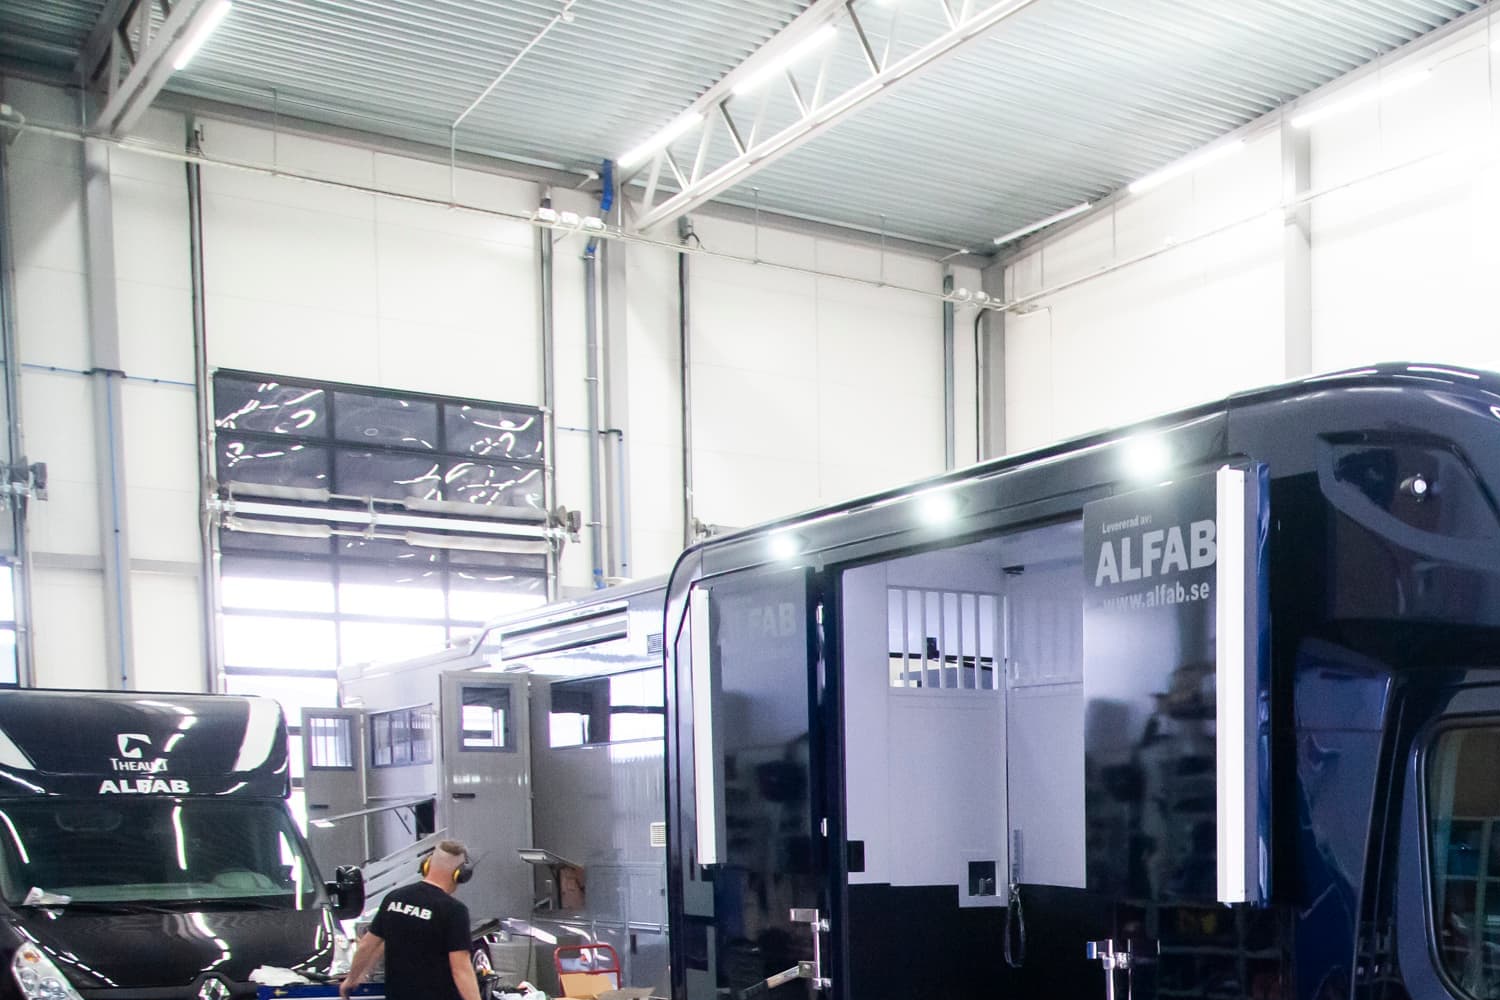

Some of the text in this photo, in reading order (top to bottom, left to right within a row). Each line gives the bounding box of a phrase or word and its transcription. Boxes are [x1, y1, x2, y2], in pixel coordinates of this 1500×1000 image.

[1094, 519, 1217, 588] ALFAB
[1103, 580, 1210, 610] www.alfab.se
[98, 779, 190, 794] ALFAB
[387, 901, 432, 920] ALFAB
